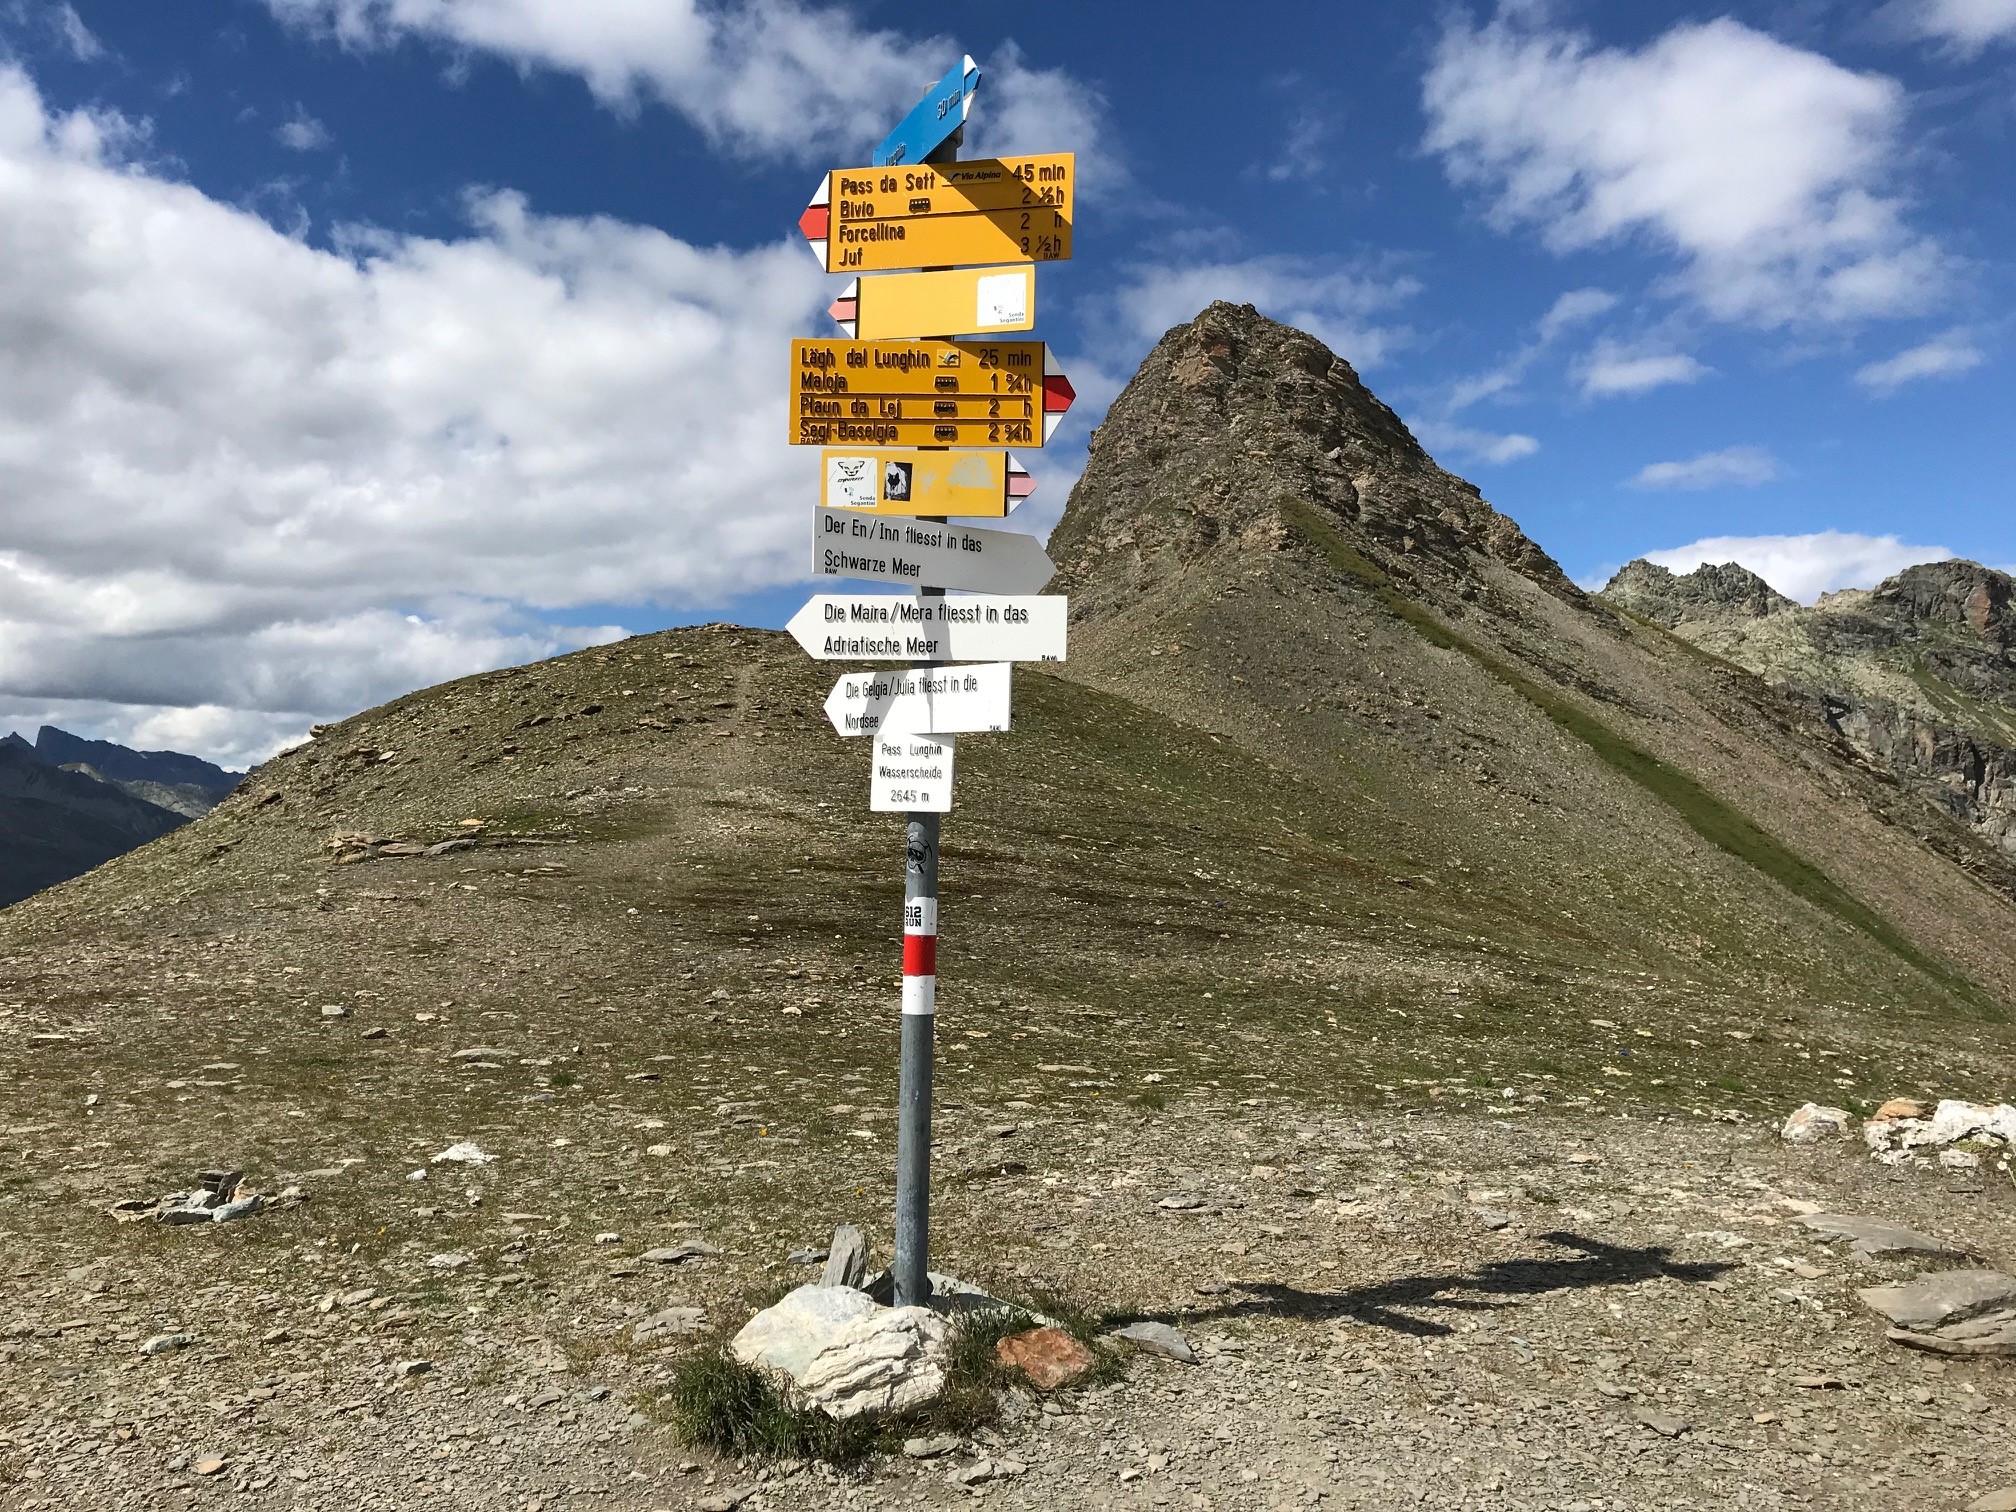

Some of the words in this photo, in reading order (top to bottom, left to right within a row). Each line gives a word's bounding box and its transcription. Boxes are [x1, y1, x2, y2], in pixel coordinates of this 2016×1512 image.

[841, 177, 873, 196] Pass
[880, 174, 897, 193] da
[905, 172, 935, 191] Sett
[1012, 163, 1035, 182] 45
[1039, 163, 1066, 182] min
[961, 172, 974, 180] Via
[975, 171, 1001, 180] Alpina
[840, 200, 874, 219] Bivio
[1021, 187, 1031, 204] 2
[839, 223, 906, 244] Forcellina
[1020, 212, 1030, 230] 2
[1054, 210, 1062, 228] h
[839, 247, 863, 267] Juf
[1020, 236, 1030, 256] 3
[1043, 252, 1060, 260] BAW
[801, 347, 836, 371] Lägh
[846, 347, 868, 368] dal
[874, 348, 930, 373] Lunghin
[978, 349, 999, 369] 25
[1007, 350, 1032, 366] min
[801, 371, 848, 393] Maloja
[990, 373, 998, 392] 1
[800, 396, 842, 417] Plaun
[850, 397, 869, 418] da
[879, 397, 903, 419] Lej
[988, 398, 1000, 418] 2
[1023, 398, 1033, 418] h
[800, 420, 898, 444] Segl-Baselgia
[988, 422, 1000, 442] 2
[825, 514, 846, 535] Der
[905, 526, 943, 548] fliesst
[946, 533, 957, 549] in
[962, 534, 982, 553] das
[824, 548, 886, 573] Schwarze
[892, 557, 921, 578] Meer
[824, 567, 838, 575] BAW
[824, 603, 845, 621] Die
[938, 603, 981, 622] fliesst
[985, 605, 998, 622] in
[1003, 604, 1028, 622] das
[823, 635, 900, 655] Adriatische
[906, 636, 938, 654] Meer
[846, 682, 859, 699] Die
[919, 677, 947, 694] fliesst
[950, 676, 960, 693] in
[963, 673, 978, 692] die
[845, 712, 879, 730] Nordsee
[881, 743, 902, 756] Pass
[909, 742, 943, 759] Lunghin
[879, 765, 943, 779] Wasserscheide
[890, 789, 917, 803] 2645
[921, 792, 930, 802] m
